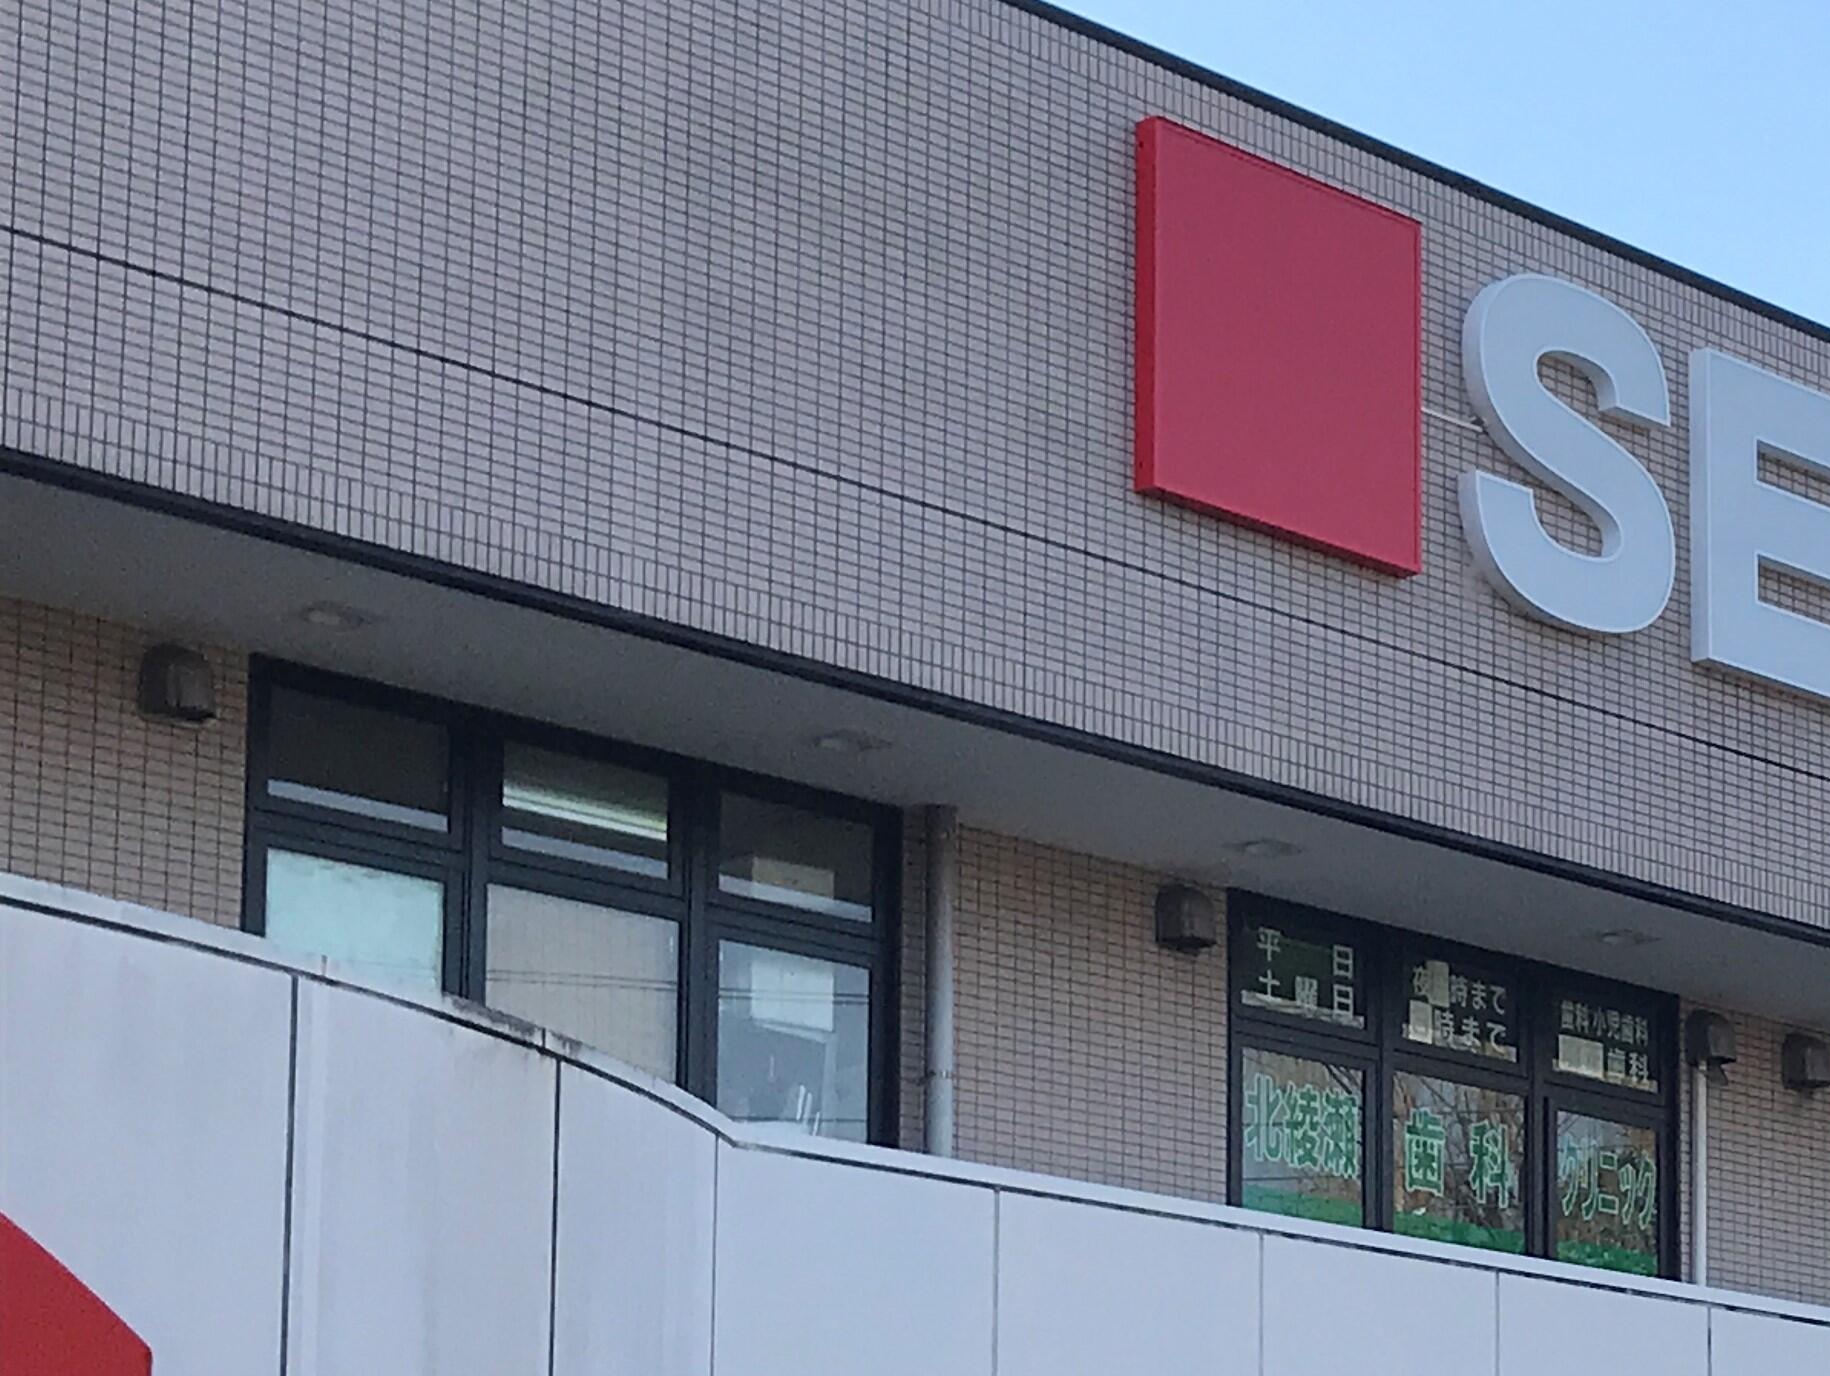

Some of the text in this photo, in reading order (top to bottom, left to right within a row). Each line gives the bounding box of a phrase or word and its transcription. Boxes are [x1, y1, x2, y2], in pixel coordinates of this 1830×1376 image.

[1258, 969, 1354, 1018] 土曜日
[1245, 1073, 1358, 1179] 北綾瀬
[1557, 1132, 1657, 1230] クリニック
